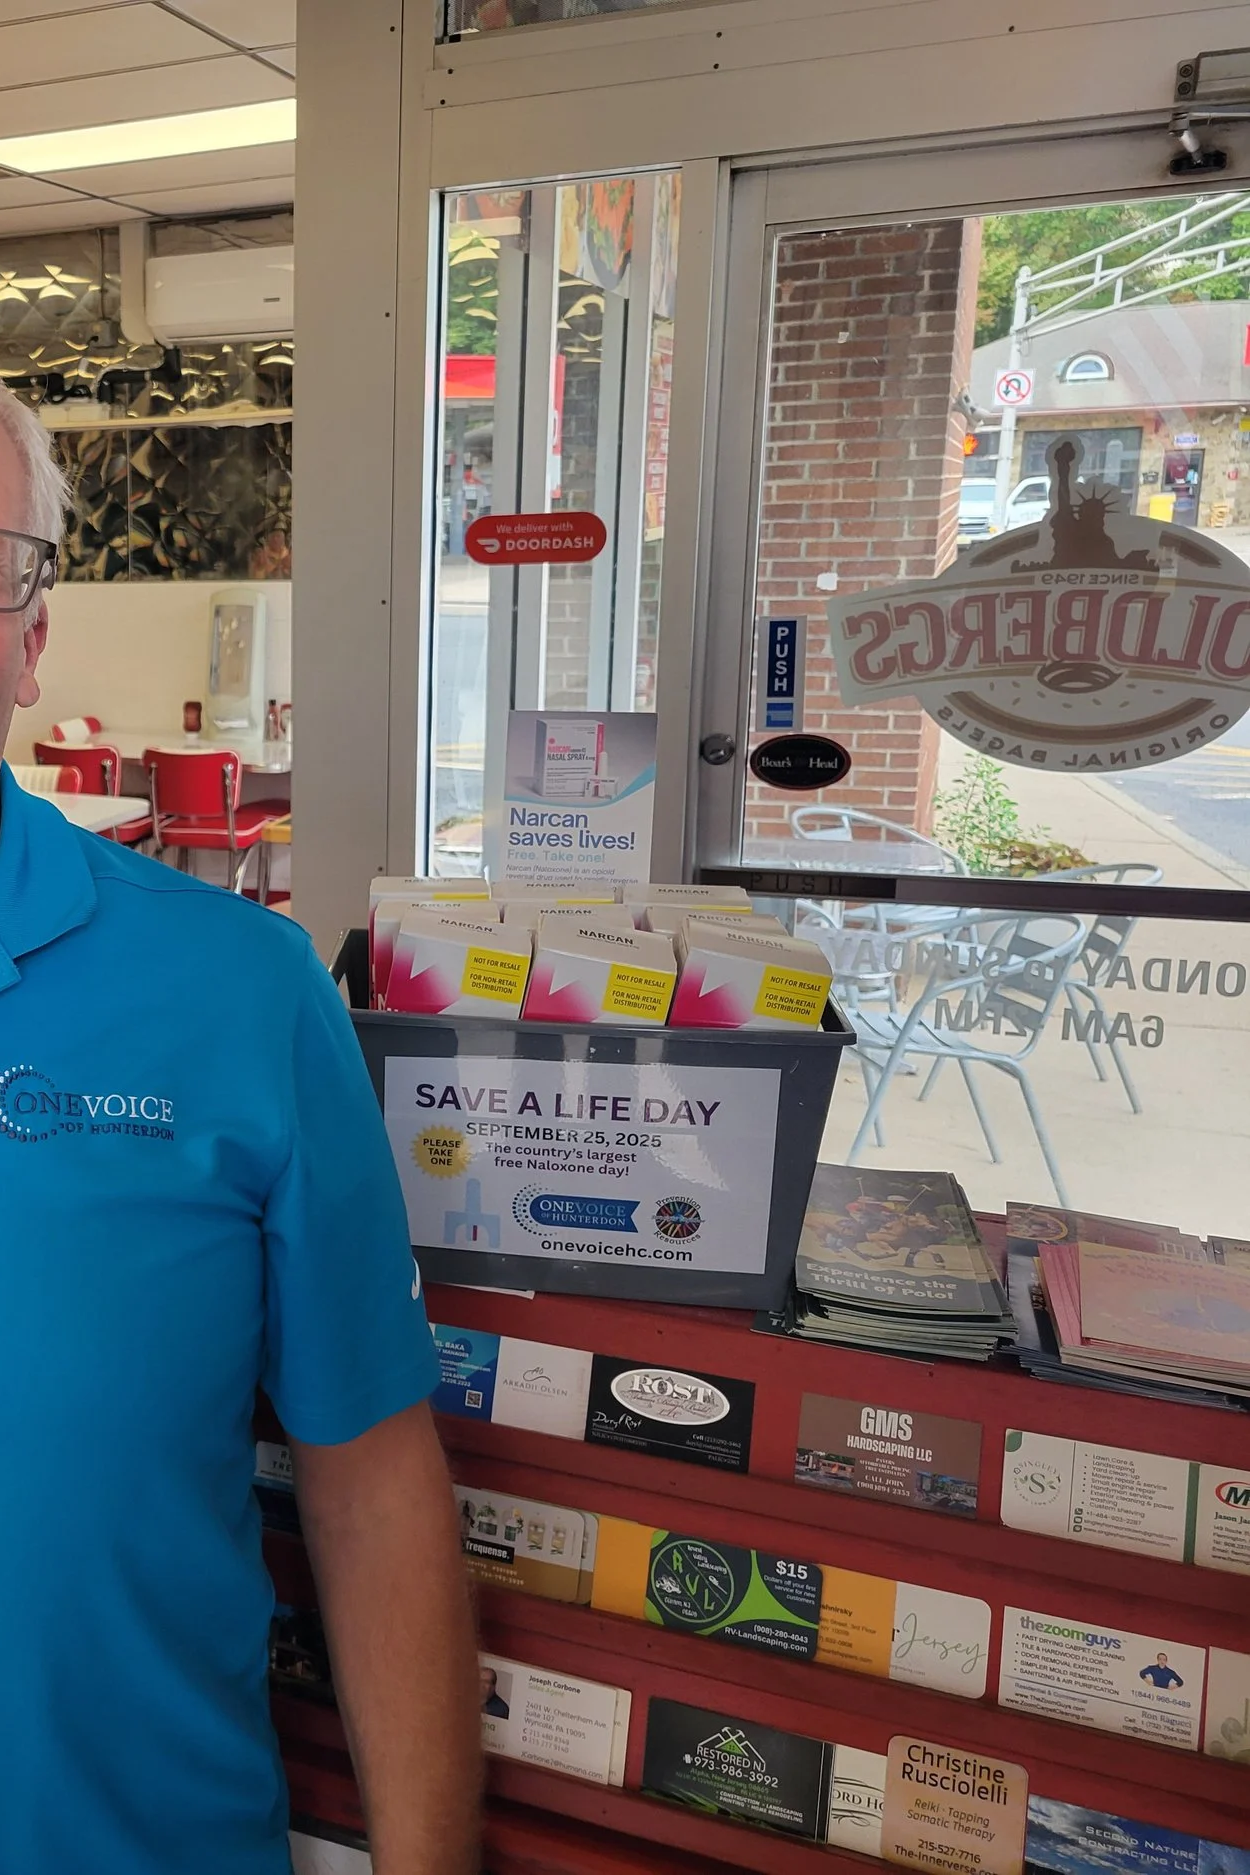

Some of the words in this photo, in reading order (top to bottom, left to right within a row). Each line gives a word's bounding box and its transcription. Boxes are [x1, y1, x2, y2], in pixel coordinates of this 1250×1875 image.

[496, 523, 512, 533] We
[514, 522, 549, 533] deliver
[551, 521, 574, 532] with
[505, 535, 595, 551] DOORDASH
[774, 625, 790, 692] PUSH
[760, 753, 792, 769] Boar's
[808, 754, 839, 769] Head
[510, 808, 589, 829] Narcan
[508, 832, 574, 849] saves
[579, 831, 636, 851] lives!
[542, 850, 574, 863] Take
[578, 851, 606, 865] one!
[506, 863, 532, 873] Narcan
[592, 867, 616, 877] opioid
[657, 887, 709, 896] NARCAN
[540, 908, 592, 916] NARCAN
[688, 913, 743, 924] NARCAN
[440, 918, 494, 933] NARCAN
[579, 927, 636, 945] NARCAN
[473, 956, 486, 966] NOT
[487, 958, 498, 968] FOR
[499, 959, 522, 971] RESALE
[470, 972, 481, 982] FOR
[482, 974, 517, 988] NON-RETAIL
[471, 981, 513, 995] DISTRIBUTION
[617, 973, 629, 983] NOT
[631, 974, 642, 984] FOR
[644, 977, 666, 988] RESALE
[771, 975, 783, 985] NOT
[785, 977, 797, 987] FOR
[798, 979, 822, 991] RESALE
[612, 990, 623, 999] FOR
[625, 992, 662, 1005] NON-RETAIL
[613, 998, 657, 1012] DISTRIBUTION
[765, 993, 777, 1003] FOR
[778, 995, 816, 1009] NON-RETAIL
[766, 1001, 811, 1016] DISTRIBUTION
[14, 1092, 175, 1123] ONEVOICE
[415, 1083, 508, 1114] SAVE
[517, 1091, 543, 1117] A
[554, 1093, 632, 1123] LIFE
[643, 1098, 721, 1126] DAY
[65, 1122, 84, 1134] OF
[90, 1123, 175, 1141] HUNTERDON
[465, 1121, 578, 1144] SEPTEMBER
[584, 1130, 611, 1148] 25,
[615, 1132, 662, 1148] 2025
[423, 1137, 461, 1149] PLEASE
[428, 1147, 454, 1158] TAKE
[430, 1157, 453, 1166] ONE
[485, 1141, 512, 1155] The
[514, 1143, 583, 1162] country's
[586, 1149, 637, 1164] largest
[494, 1156, 523, 1169] free
[526, 1158, 595, 1174] Naloxone
[597, 1164, 630, 1178] day!
[540, 1199, 626, 1217] ONEVOICE
[655, 1195, 702, 1212] Prevention
[552, 1213, 625, 1227] HUNTERDON
[653, 1229, 702, 1245] Resources
[540, 1239, 694, 1263] onevoicehc.com
[806, 1263, 917, 1287] Experience
[921, 1279, 957, 1290] the
[811, 1272, 868, 1290] Thrill
[873, 1285, 896, 1296] of
[902, 1287, 954, 1300] Polo!
[540, 1384, 568, 1397] OLSEN
[629, 1374, 715, 1404] ROST
[859, 1405, 914, 1441] GMS
[846, 1434, 914, 1459] HARDSCAPING
[915, 1447, 933, 1463] LLC
[1092, 1460, 1136, 1474] Landscaping
[1029, 1472, 1047, 1494] S
[1091, 1478, 1111, 1487] Small
[1111, 1481, 1136, 1492] engine
[1143, 1480, 1168, 1491] service
[1089, 1496, 1118, 1507] washing
[1090, 1484, 1128, 1496] Handyman
[1129, 1489, 1154, 1501] service
[1115, 1493, 1146, 1507] cleaning
[1117, 1506, 1145, 1518] shelving
[464, 1543, 510, 1561] frequense.
[775, 1559, 809, 1580] $15
[775, 1584, 793, 1594] service
[786, 1593, 816, 1605] customers
[753, 1623, 809, 1644] (908)-280-4043
[1019, 1615, 1122, 1650] thezoomguys
[895, 1612, 987, 1675] Jersey
[1021, 1633, 1037, 1643] FAST
[1038, 1636, 1064, 1648] DRYING
[1064, 1641, 1091, 1653] CARPET
[1091, 1646, 1126, 1662] CLEANING
[1020, 1650, 1039, 1662] ODOR
[1039, 1654, 1071, 1668] REMOVAL
[1072, 1661, 1103, 1675] EXPERTS
[1041, 1645, 1080, 1661] HARDWOOD
[1081, 1653, 1109, 1667] FLOORS
[529, 1675, 552, 1688] Joseph
[1019, 1659, 1048, 1672] SIMPLER
[1048, 1664, 1068, 1677] MOLD
[1068, 1668, 1114, 1687] REMEDIATION
[1019, 1667, 1055, 1682] SANITIZING
[1073, 1679, 1120, 1696] PURIFICATION
[696, 1744, 751, 1769] RESTORED
[906, 1744, 1005, 1785] Christine
[693, 1756, 780, 1788] 973-986-3992
[901, 1762, 1009, 1806] Rusciolelli
[719, 1790, 761, 1806] CONSTRUCTION
[765, 1803, 804, 1819] LANDSCAPING
[719, 1796, 745, 1809] PAINTING
[767, 1809, 804, 1824] REMODELING
[914, 1798, 940, 1812] Reiki
[947, 1805, 990, 1828] Tapping
[906, 1809, 951, 1831] Somatic
[952, 1820, 996, 1842] Therapy
[917, 1838, 982, 1865] 215-527-7716
